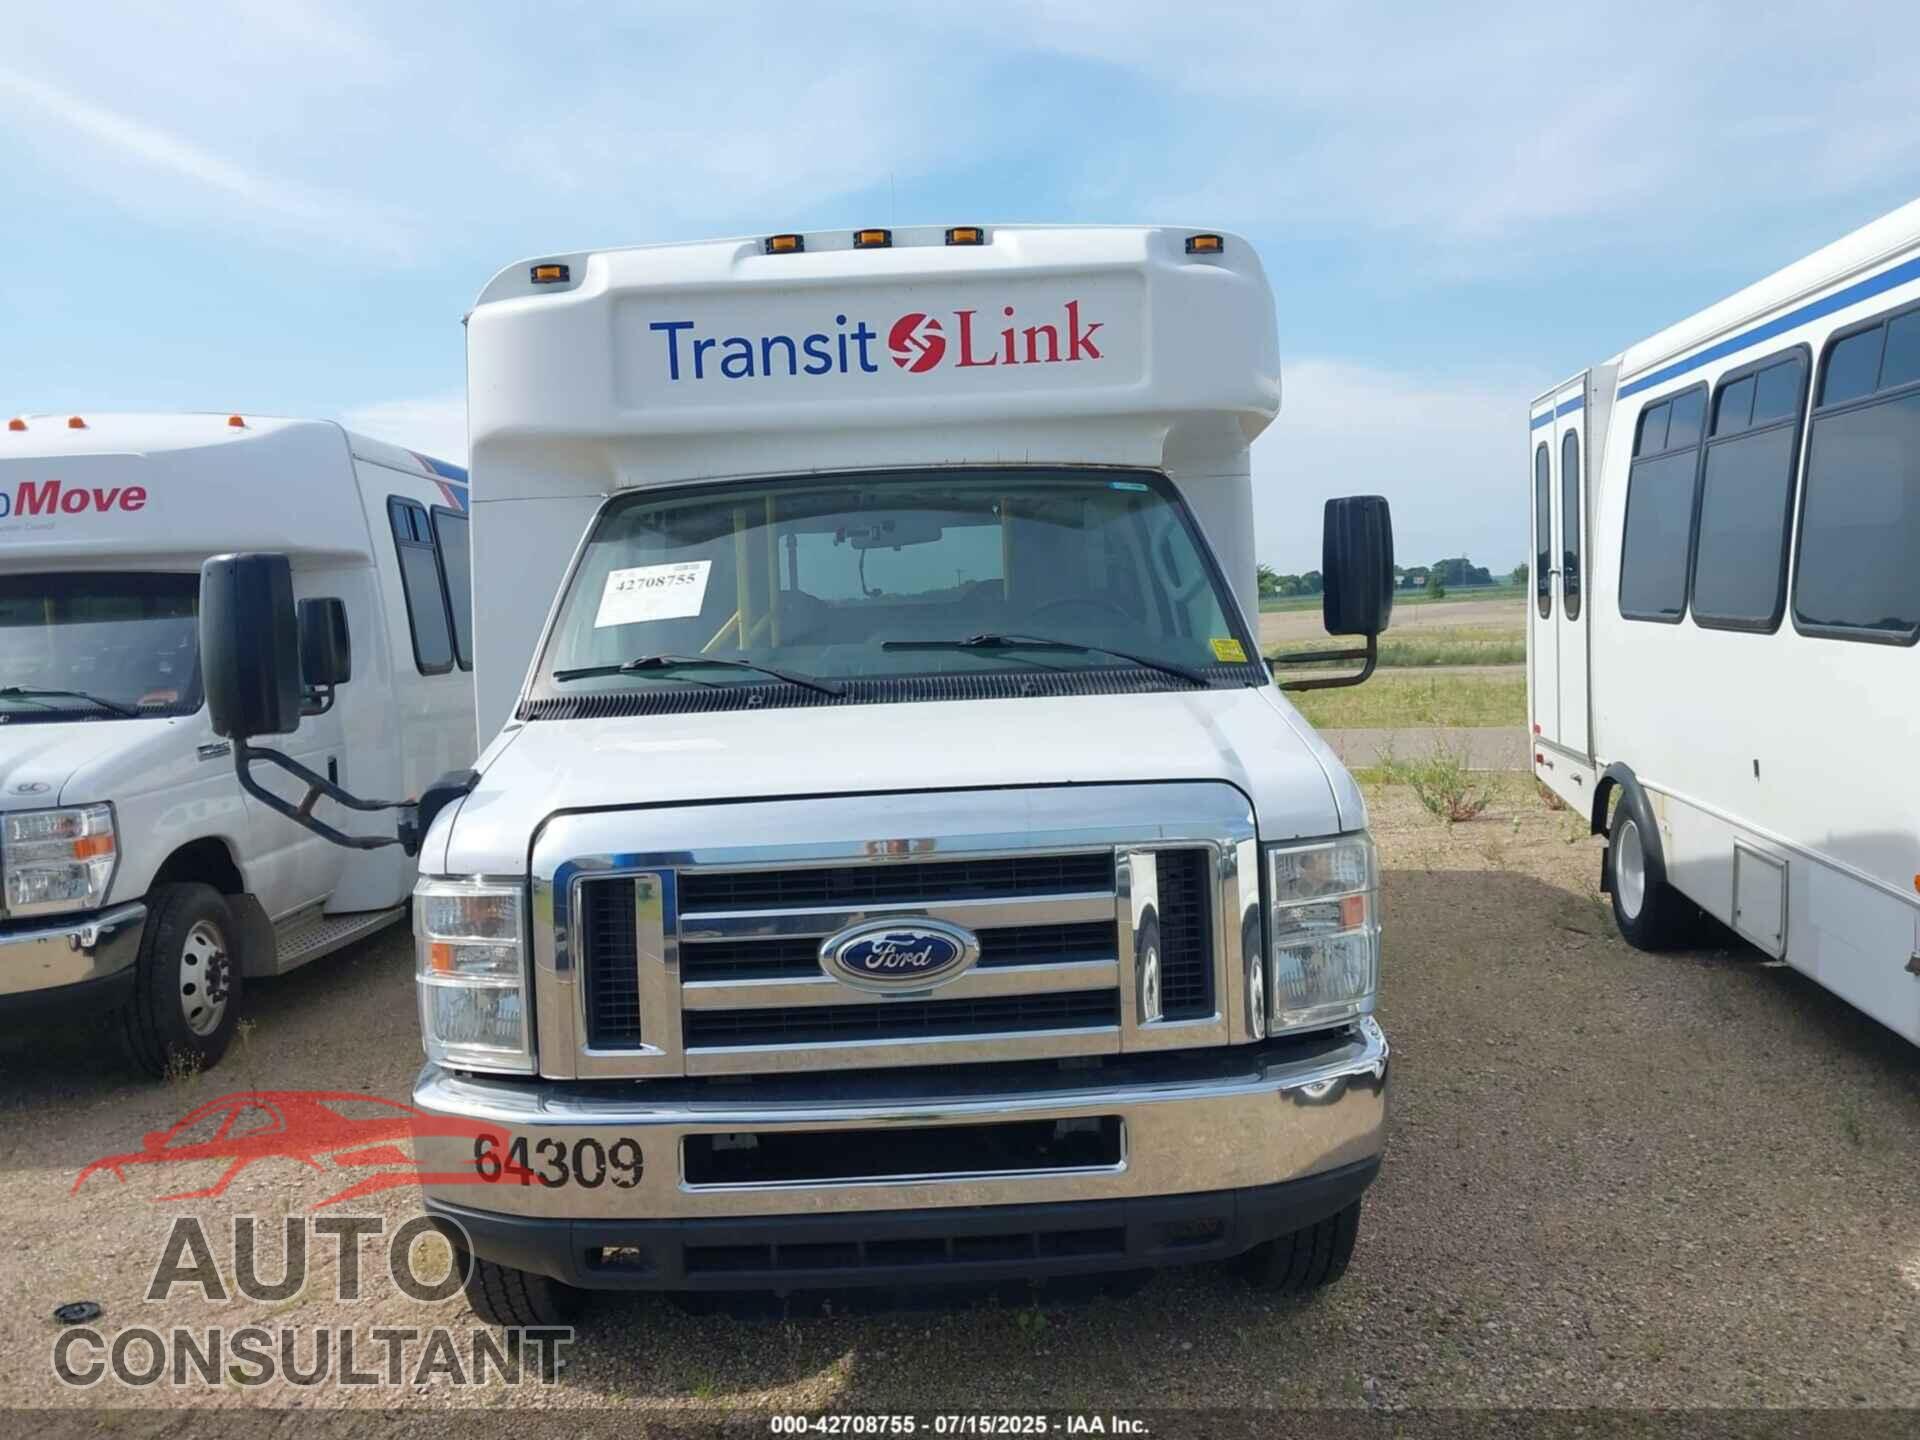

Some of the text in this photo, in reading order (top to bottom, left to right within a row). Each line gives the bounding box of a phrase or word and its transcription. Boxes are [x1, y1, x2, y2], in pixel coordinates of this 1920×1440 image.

[649, 313, 878, 380] Transit
[615, 572, 697, 591] 42708755
[865, 936, 933, 969] Ford
[473, 1133, 644, 1189] 64309
